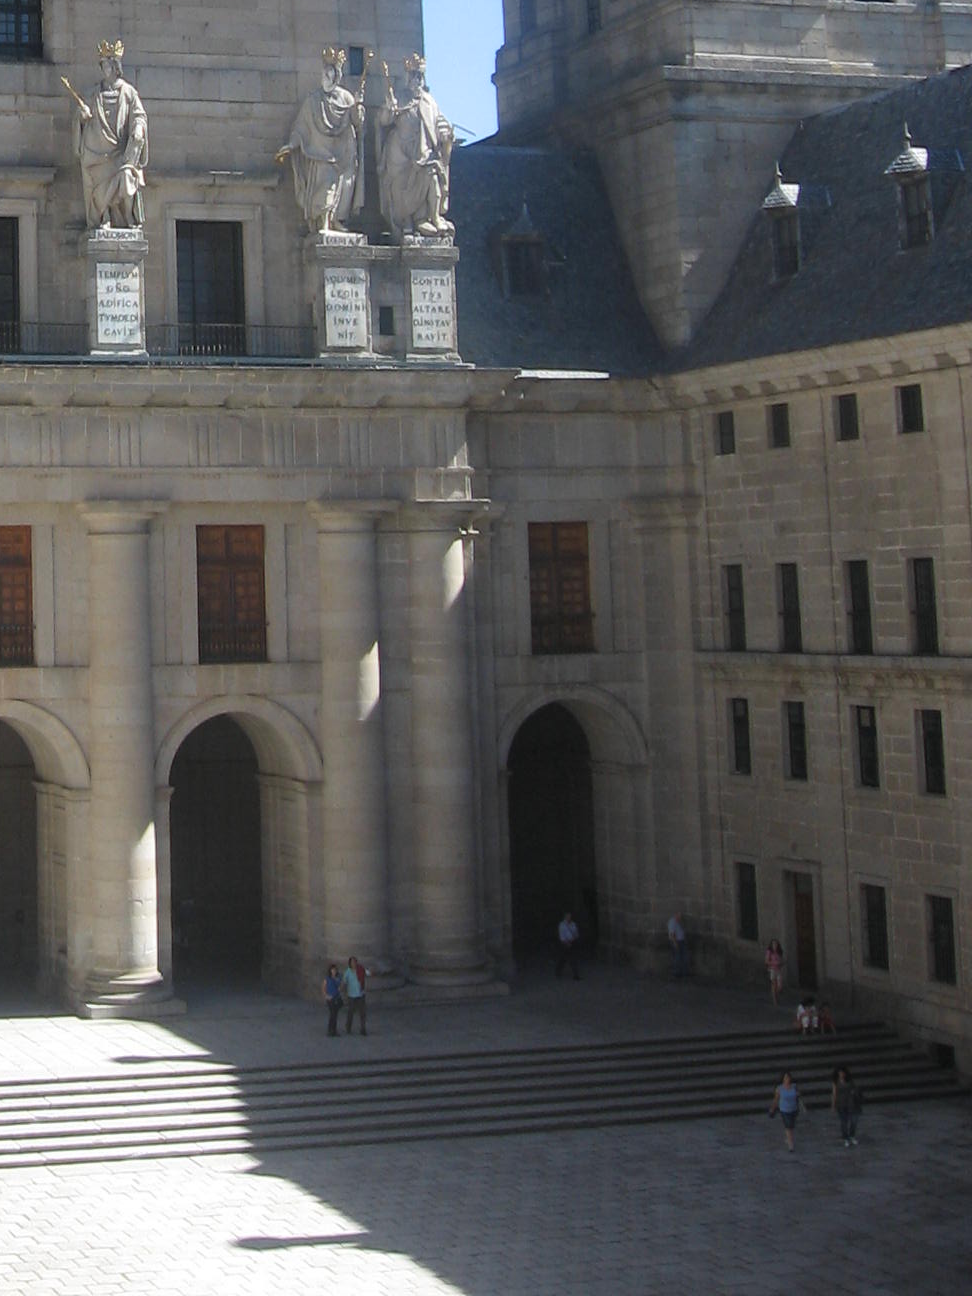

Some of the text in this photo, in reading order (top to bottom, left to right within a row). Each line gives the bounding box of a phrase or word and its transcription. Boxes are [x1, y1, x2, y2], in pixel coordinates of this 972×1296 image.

[98, 270, 138, 280] TEMPLVM
[326, 301, 367, 313] DOMINI
[413, 305, 451, 314] ALTARE
[333, 315, 359, 326] INVE
